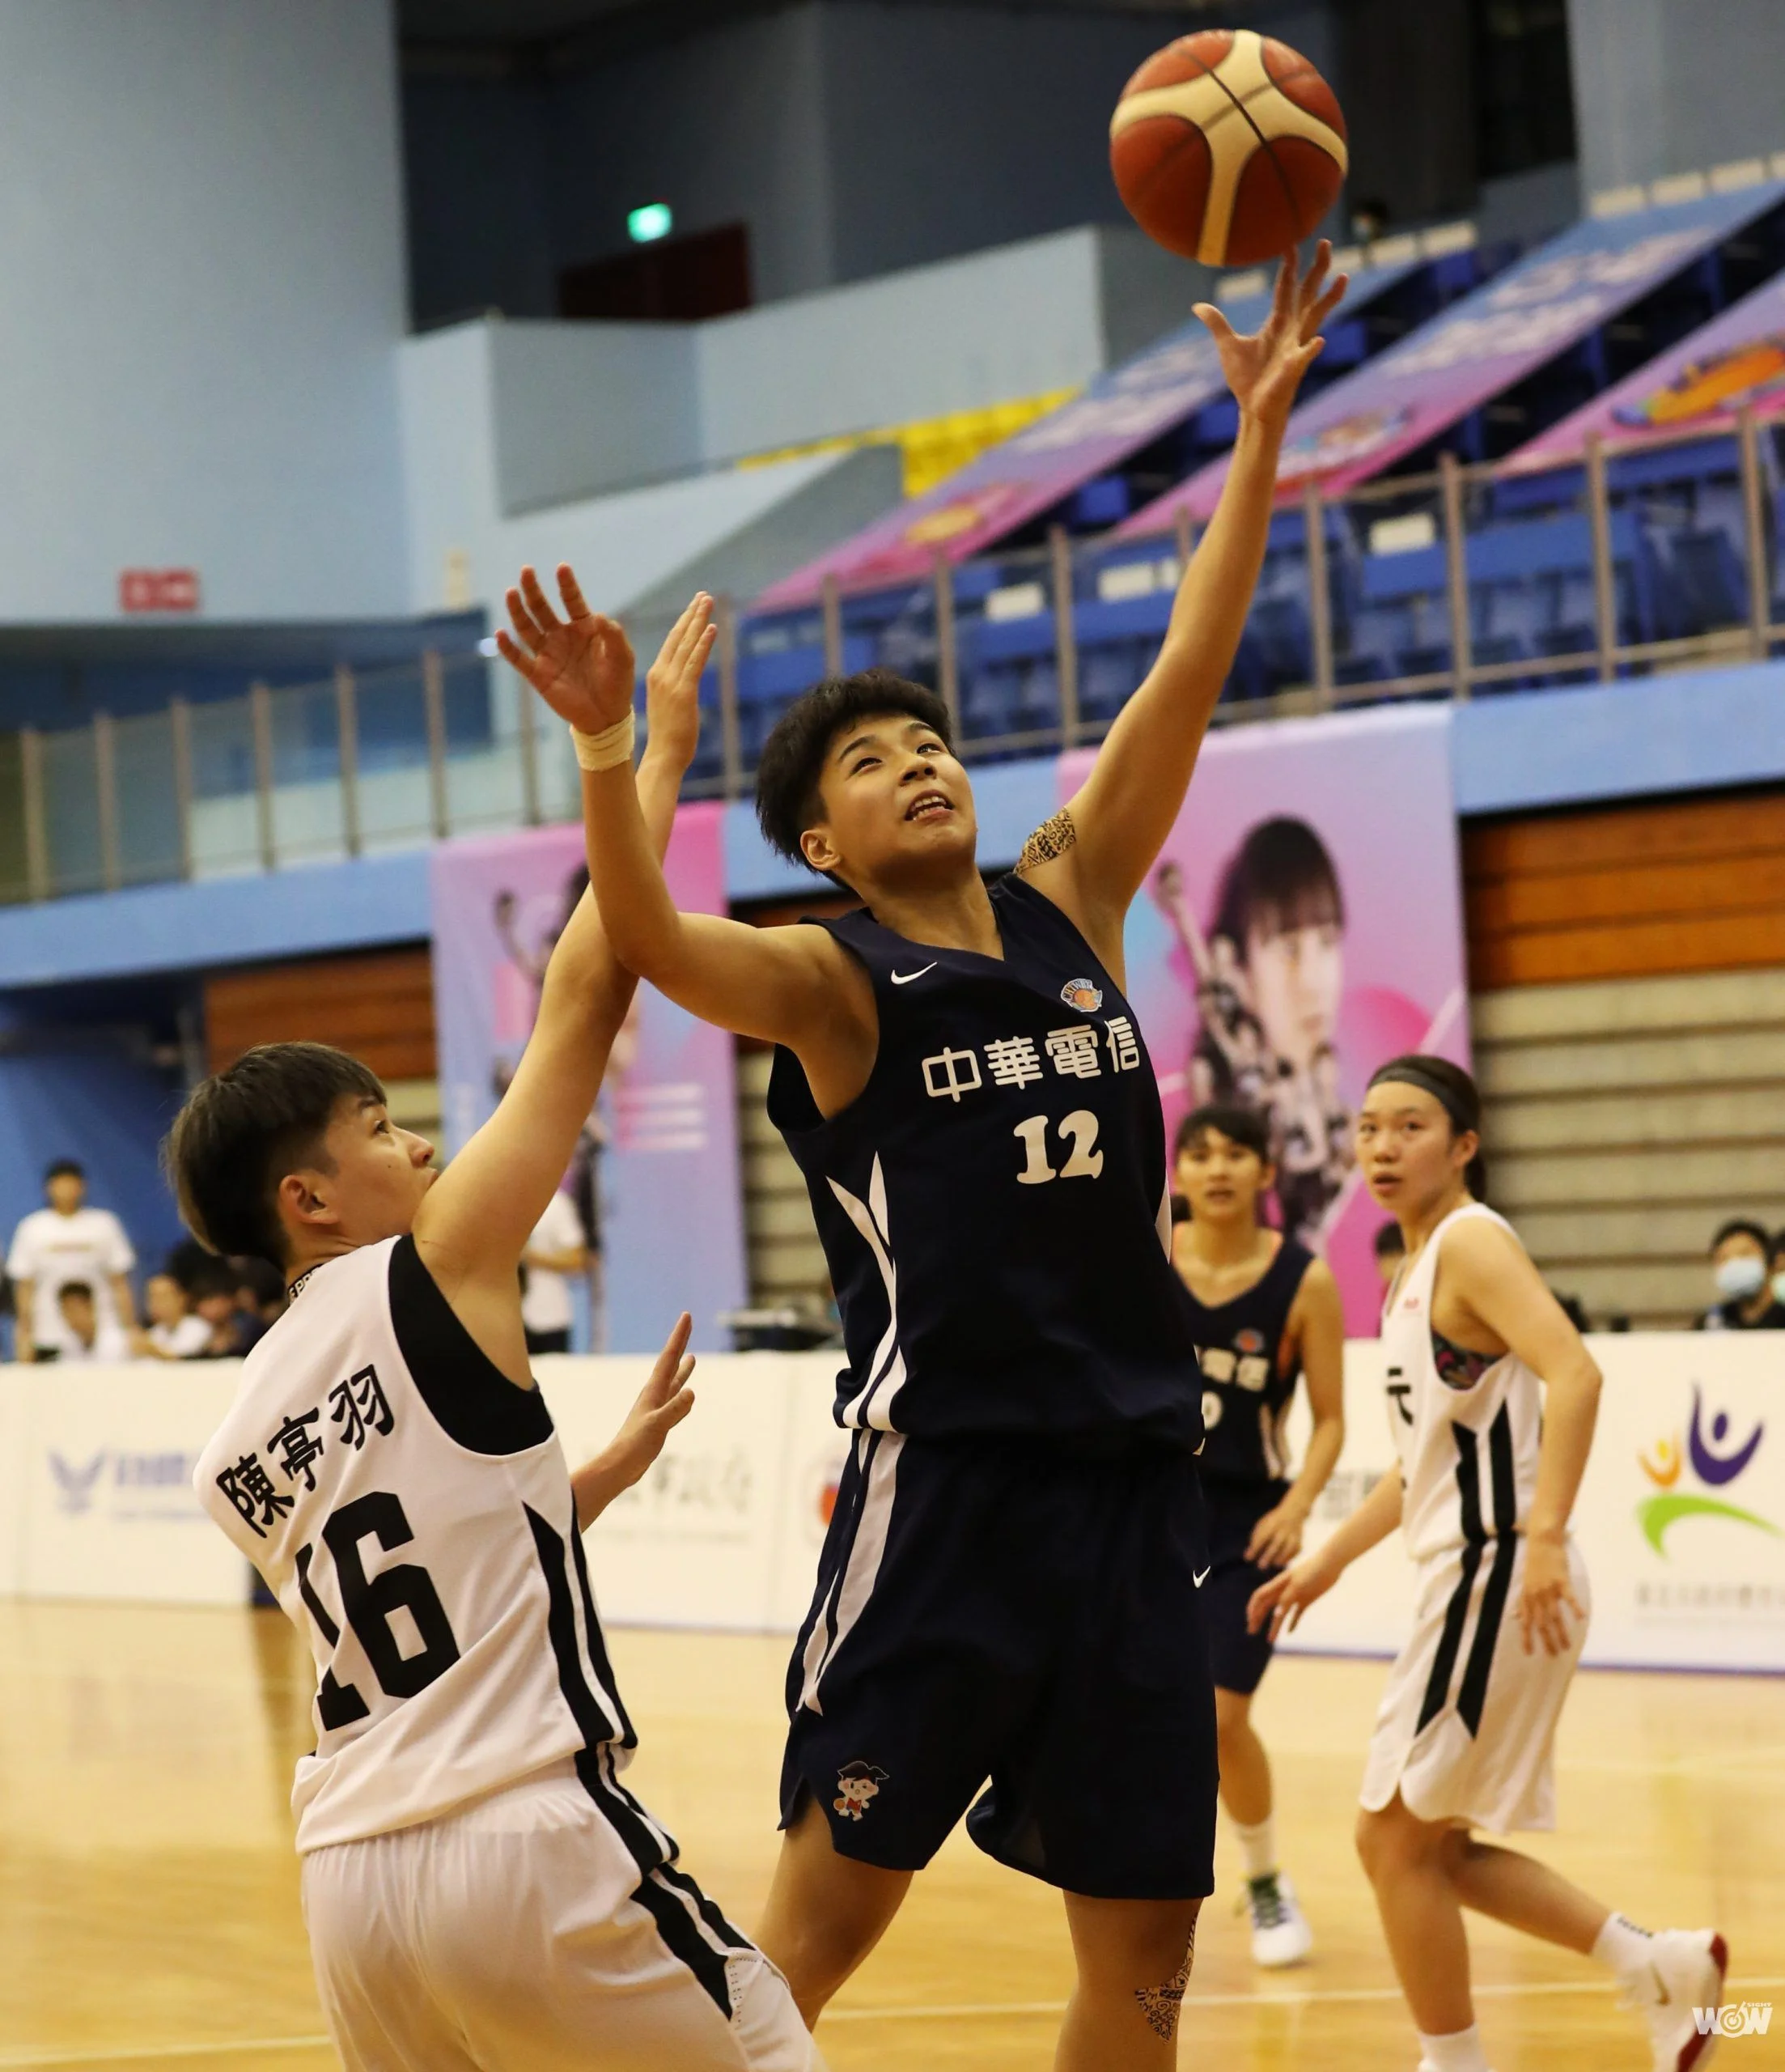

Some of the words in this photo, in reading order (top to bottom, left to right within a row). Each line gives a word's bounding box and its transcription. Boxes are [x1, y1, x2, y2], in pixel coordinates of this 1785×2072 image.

[921, 1016, 1140, 1102] 中華電信
[1013, 1110, 1104, 1184] 12
[215, 1364, 395, 1539] 陳亭羽
[295, 1491, 461, 1731] 16
